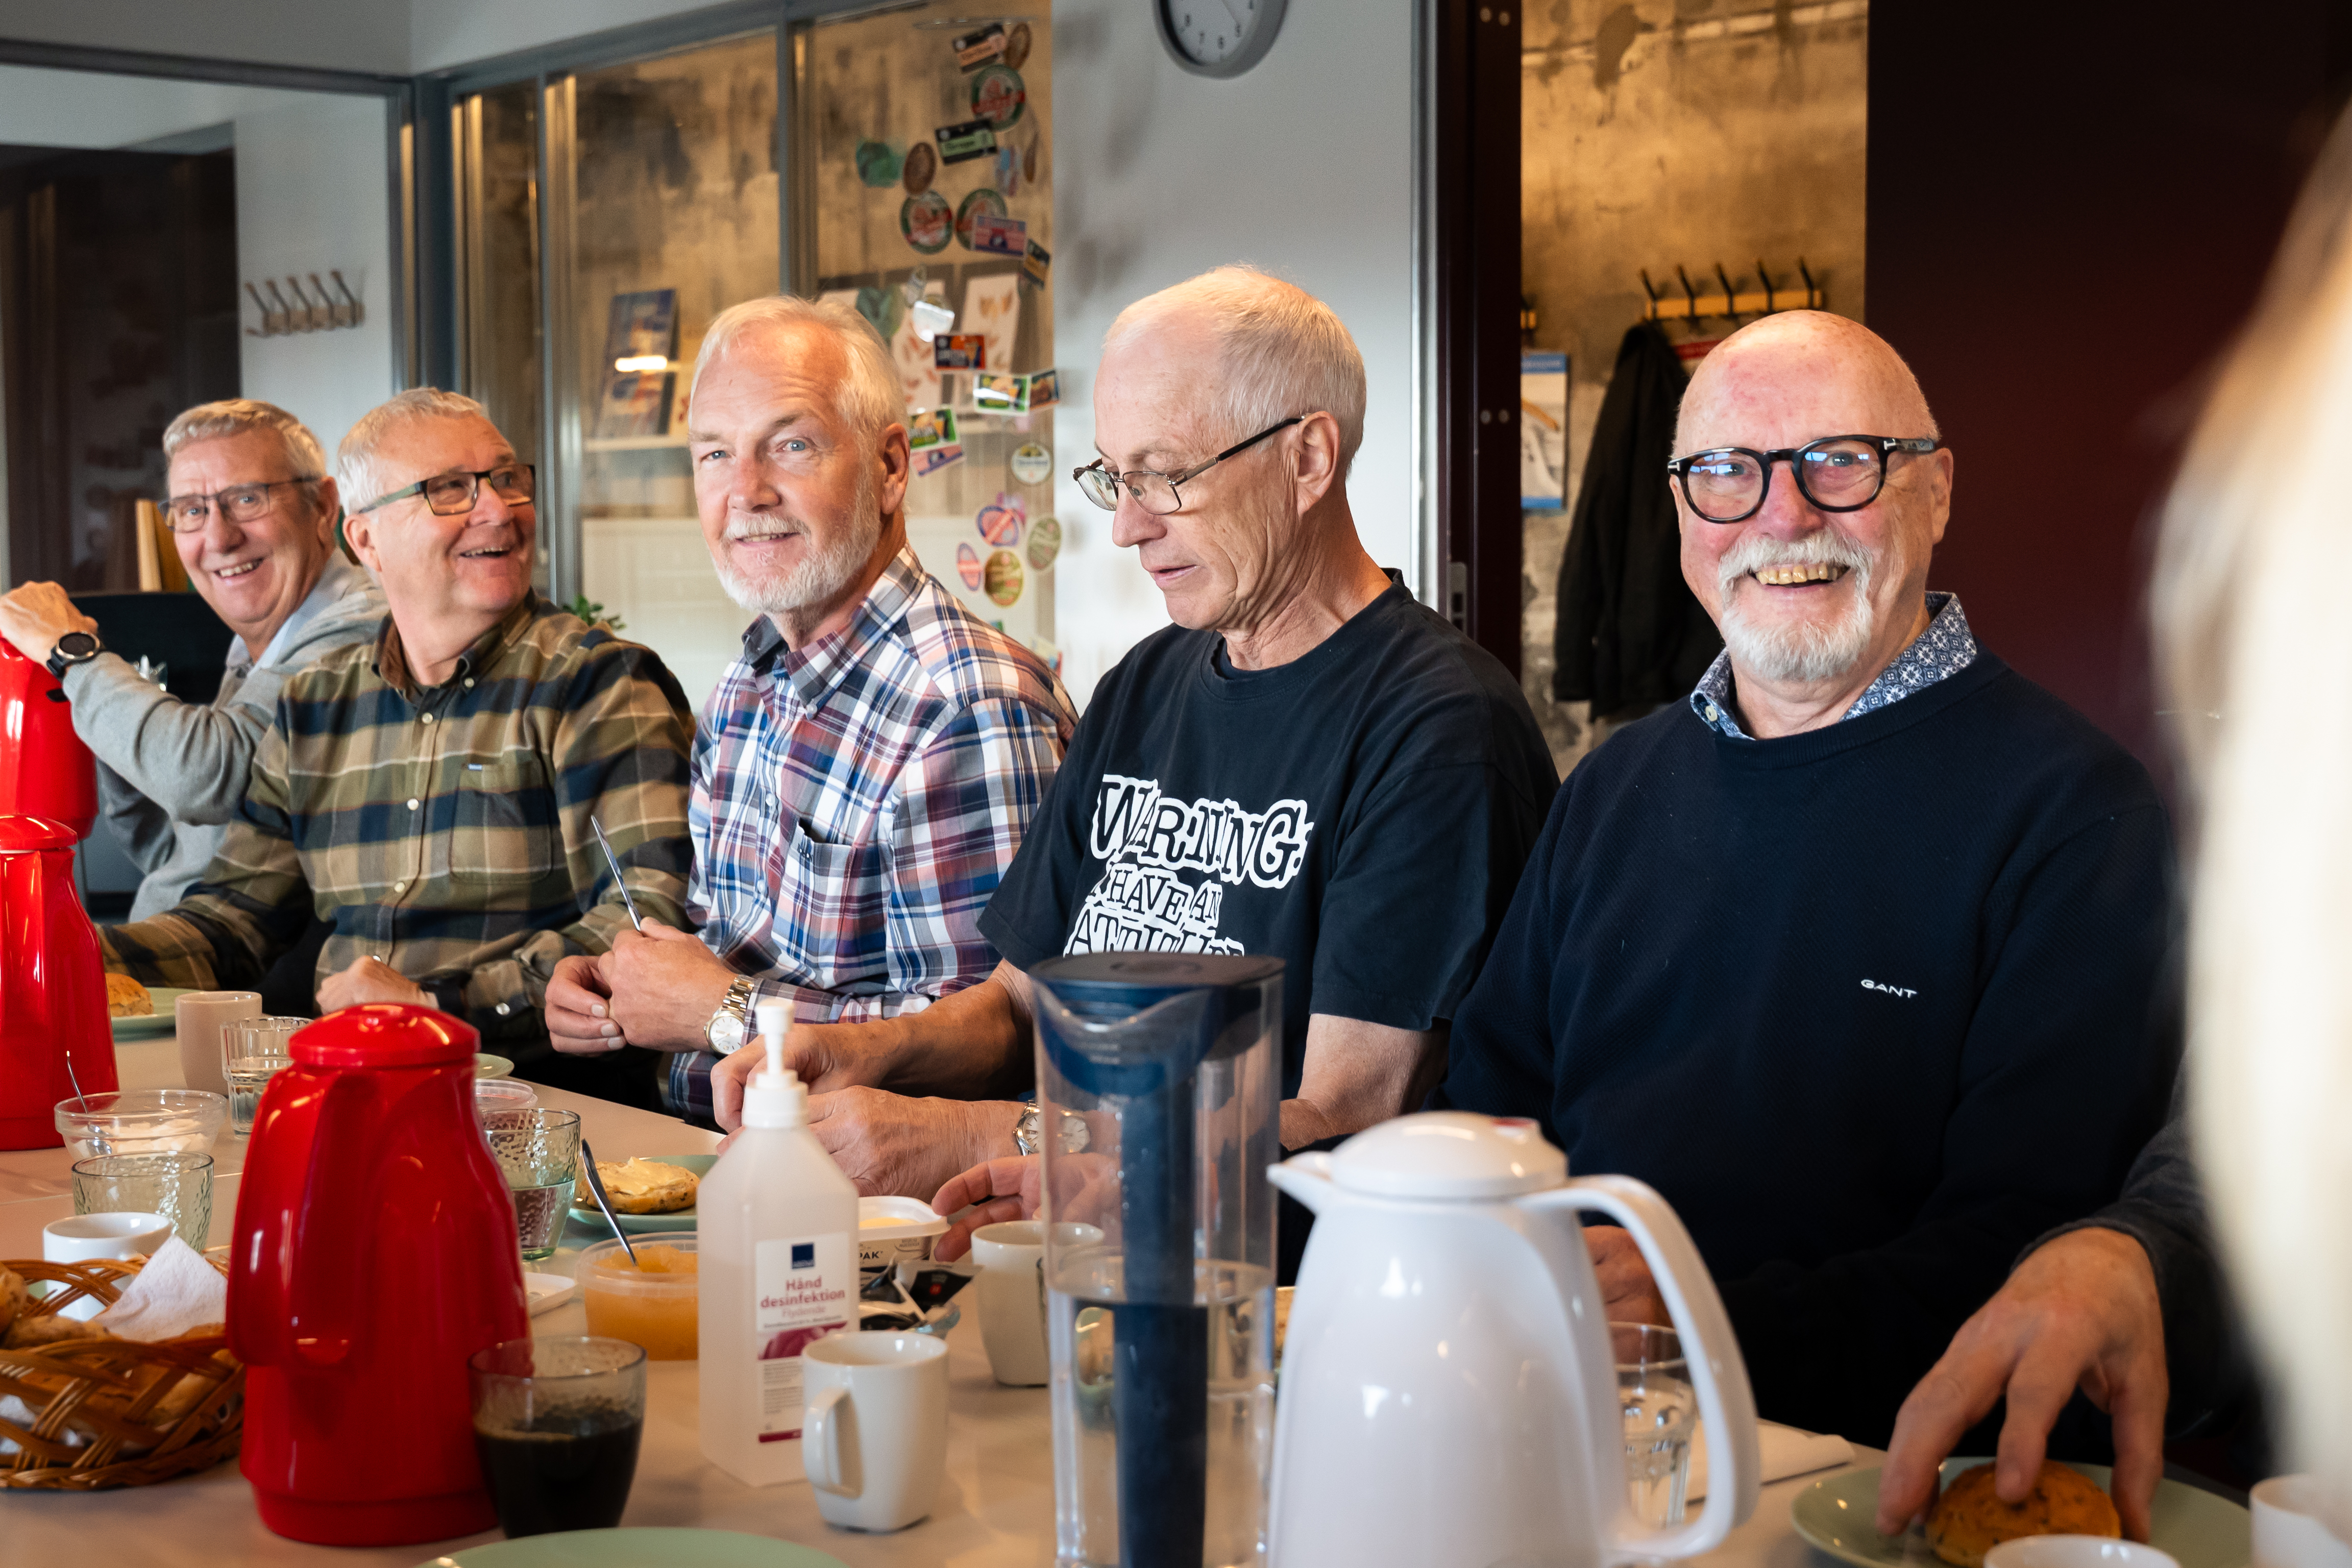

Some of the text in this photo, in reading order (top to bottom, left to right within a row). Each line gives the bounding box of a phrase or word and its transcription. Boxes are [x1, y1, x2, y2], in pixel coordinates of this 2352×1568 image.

[1094, 778, 1306, 885] WARNING
[1106, 869, 1189, 926] HAVE
[1188, 887, 1222, 923] AN
[1065, 908, 1244, 958] ATTIT
[1860, 979, 1917, 998] GANT
[760, 1288, 846, 1309] desinfektion
[785, 1275, 822, 1291] Hånd
